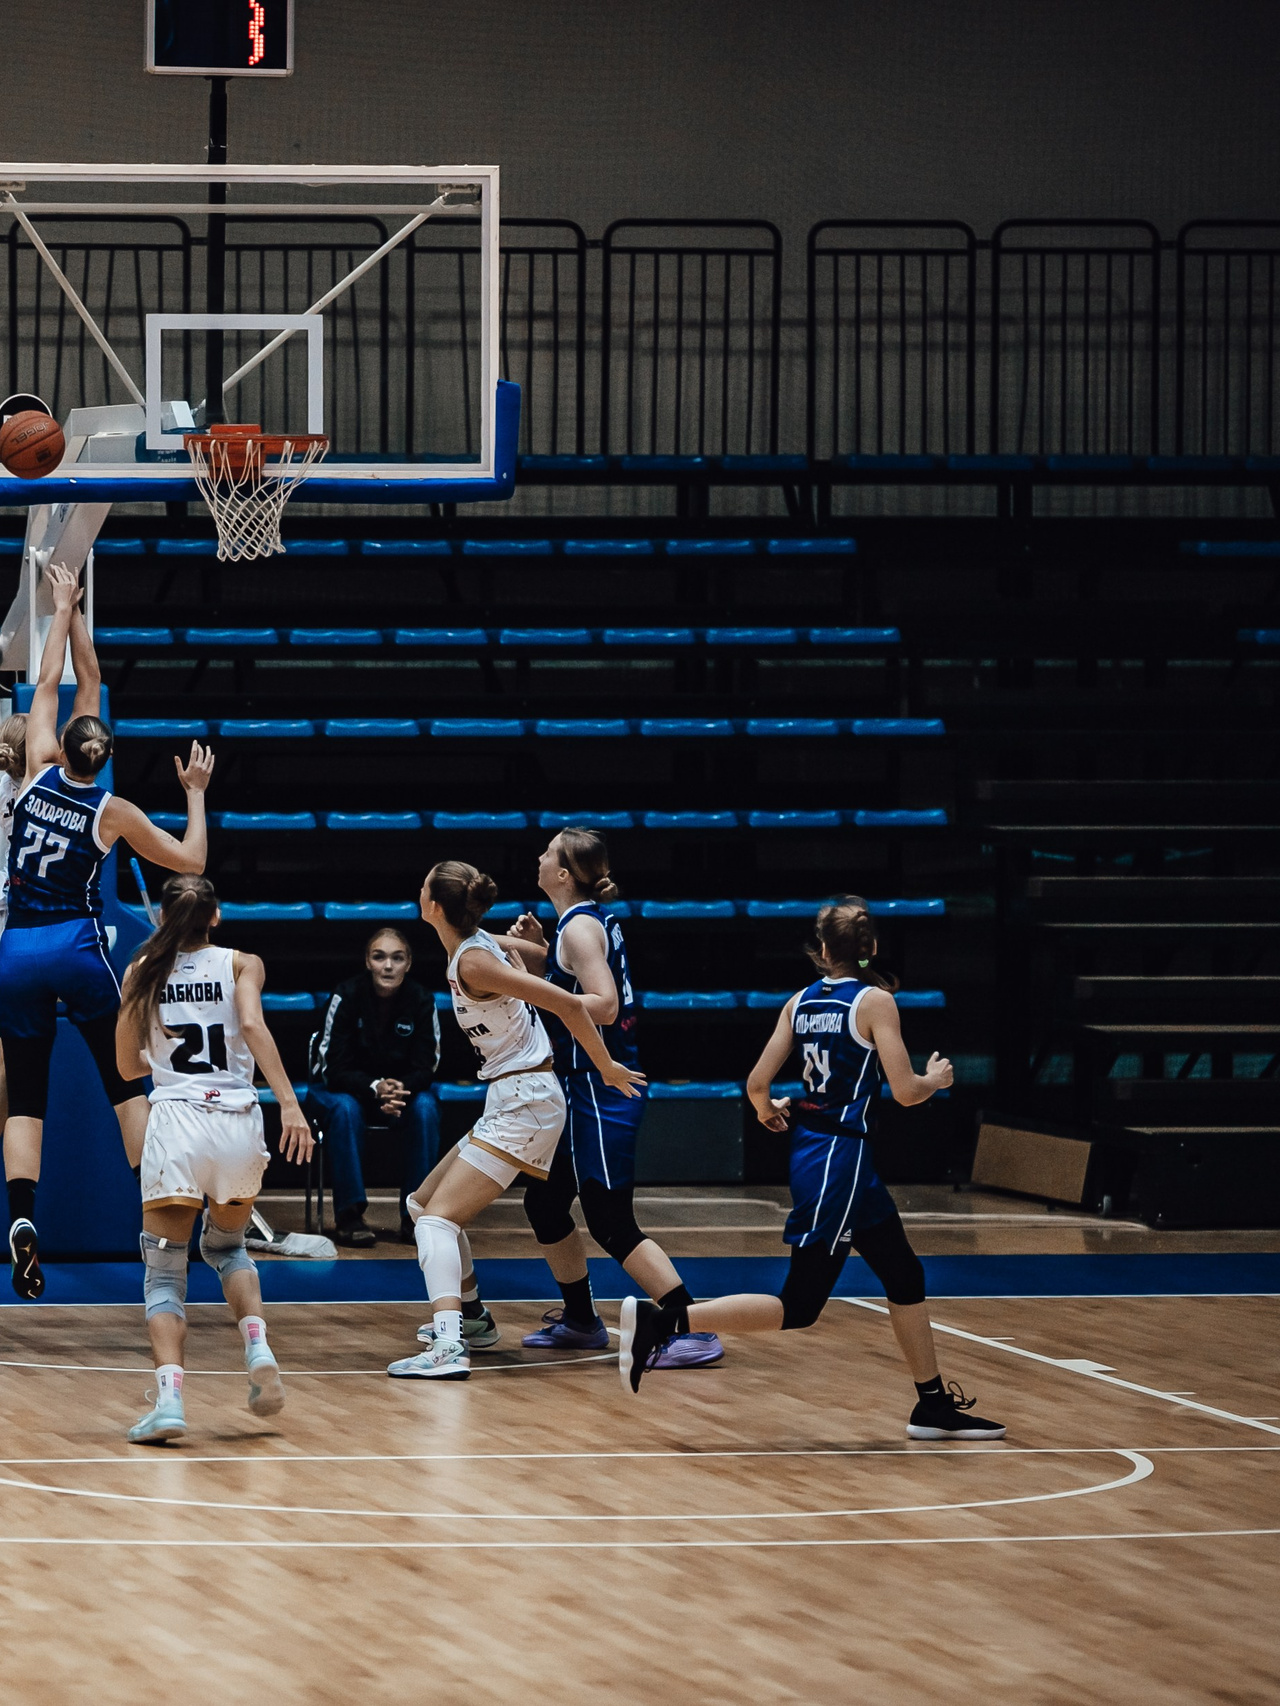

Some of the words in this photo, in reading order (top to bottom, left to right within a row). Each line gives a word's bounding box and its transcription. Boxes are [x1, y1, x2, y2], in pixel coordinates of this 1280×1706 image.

[24, 794, 87, 833] ЗАХАРОВА
[17, 821, 70, 878] 77
[163, 1023, 228, 1074] 21
